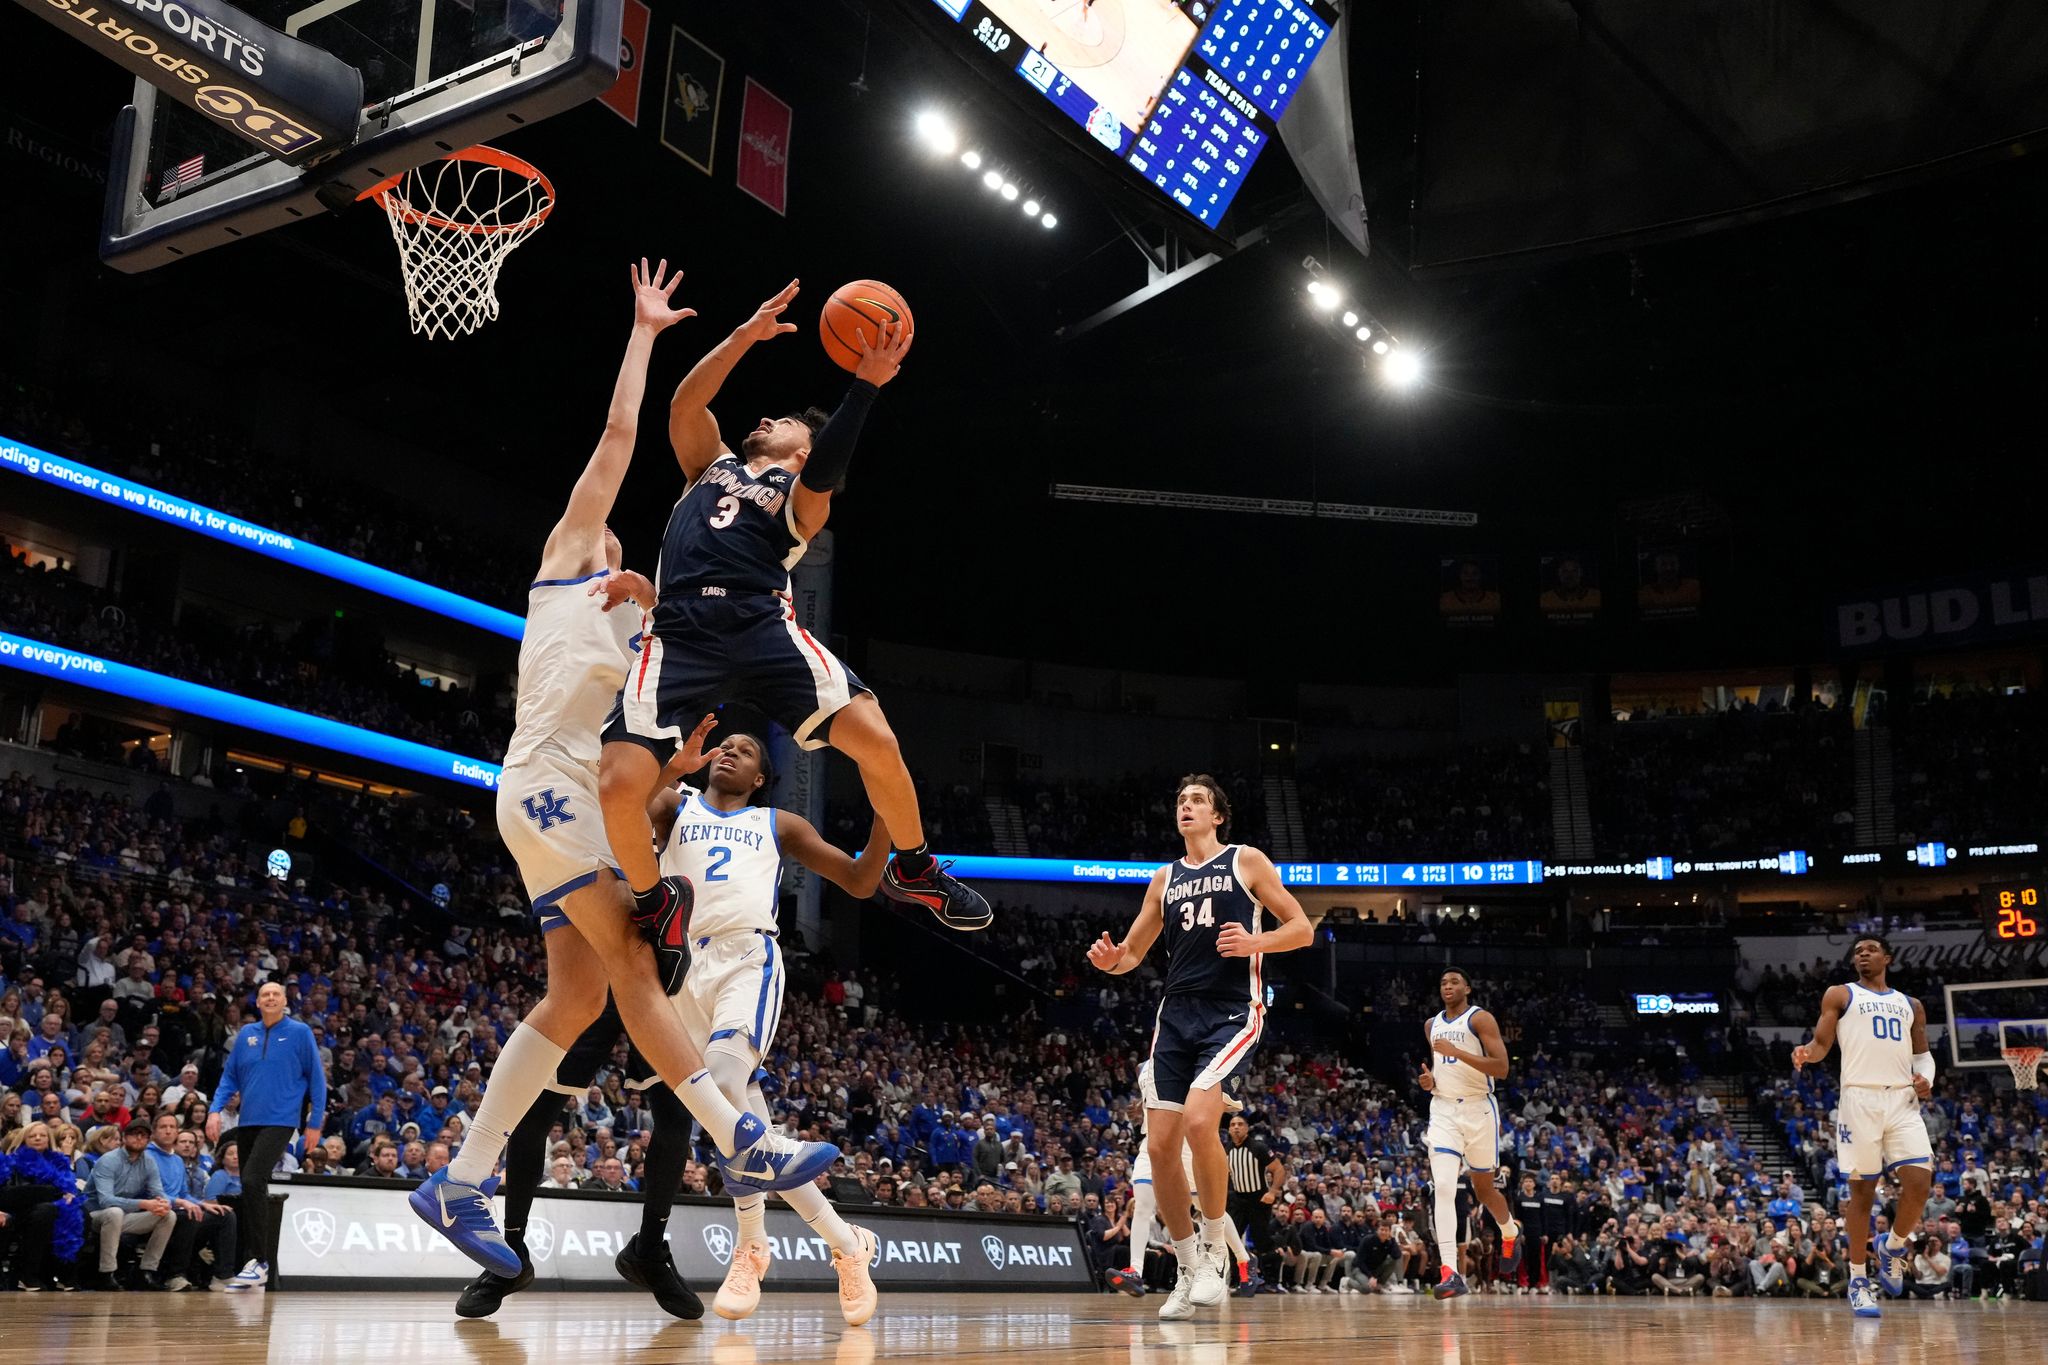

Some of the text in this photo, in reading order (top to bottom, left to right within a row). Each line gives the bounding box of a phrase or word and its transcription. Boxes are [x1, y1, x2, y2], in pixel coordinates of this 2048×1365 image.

[978, 17, 1011, 51] 8:10
[1032, 61, 1048, 78] 21
[1204, 68, 1258, 119] TEAM STATS
[1157, 103, 1172, 119] FT
[1191, 157, 1211, 175] AST
[700, 466, 786, 517] GONZAGA
[42, 460, 100, 490] cancer
[101, 480, 121, 498] as
[123, 489, 146, 506] we
[147, 494, 188, 520] know
[190, 510, 203, 526] it,
[206, 513, 227, 532] for
[228, 522, 296, 551] everyone.
[709, 496, 740, 530] 3
[701, 586, 727, 597] ZAGS
[1837, 587, 1981, 648] BUD
[22, 645, 108, 674] everyone.
[452, 760, 494, 787] Ending
[520, 787, 576, 833] UK
[679, 824, 763, 851] KENTUCKY
[705, 846, 732, 882] 2
[1296, 865, 1313, 873] PTS
[1567, 865, 1592, 875] FIELD
[1593, 864, 1622, 875] GOALS
[1842, 853, 1882, 864] ASSISTS
[1073, 864, 1155, 880] Ending cance
[1296, 874, 1313, 882] FLS
[1336, 866, 1349, 881] 2
[1363, 865, 1380, 873] PTS
[1363, 874, 1380, 882] FLS
[1402, 866, 1416, 881] 4
[1430, 865, 1447, 873] PTS
[1430, 874, 1447, 882] FLS
[1462, 865, 1484, 880] 10
[1498, 864, 1515, 872] PTS
[1498, 872, 1515, 880] FLS
[1166, 875, 1233, 905] GONZAGA
[2000, 888, 2037, 908] 8:10
[1179, 897, 1216, 932] 34
[1997, 909, 2037, 939] 26
[1673, 1003, 1720, 1013] SPORTS
[1858, 1002, 1911, 1022] KENTUCKY
[1872, 1015, 1903, 1042] 00
[1838, 1123, 1853, 1144] UK
[342, 1220, 456, 1253] ARIA
[767, 1236, 829, 1261] RIAT
[885, 1240, 962, 1264] ARIAT
[1007, 1244, 1073, 1267] ARIAT
